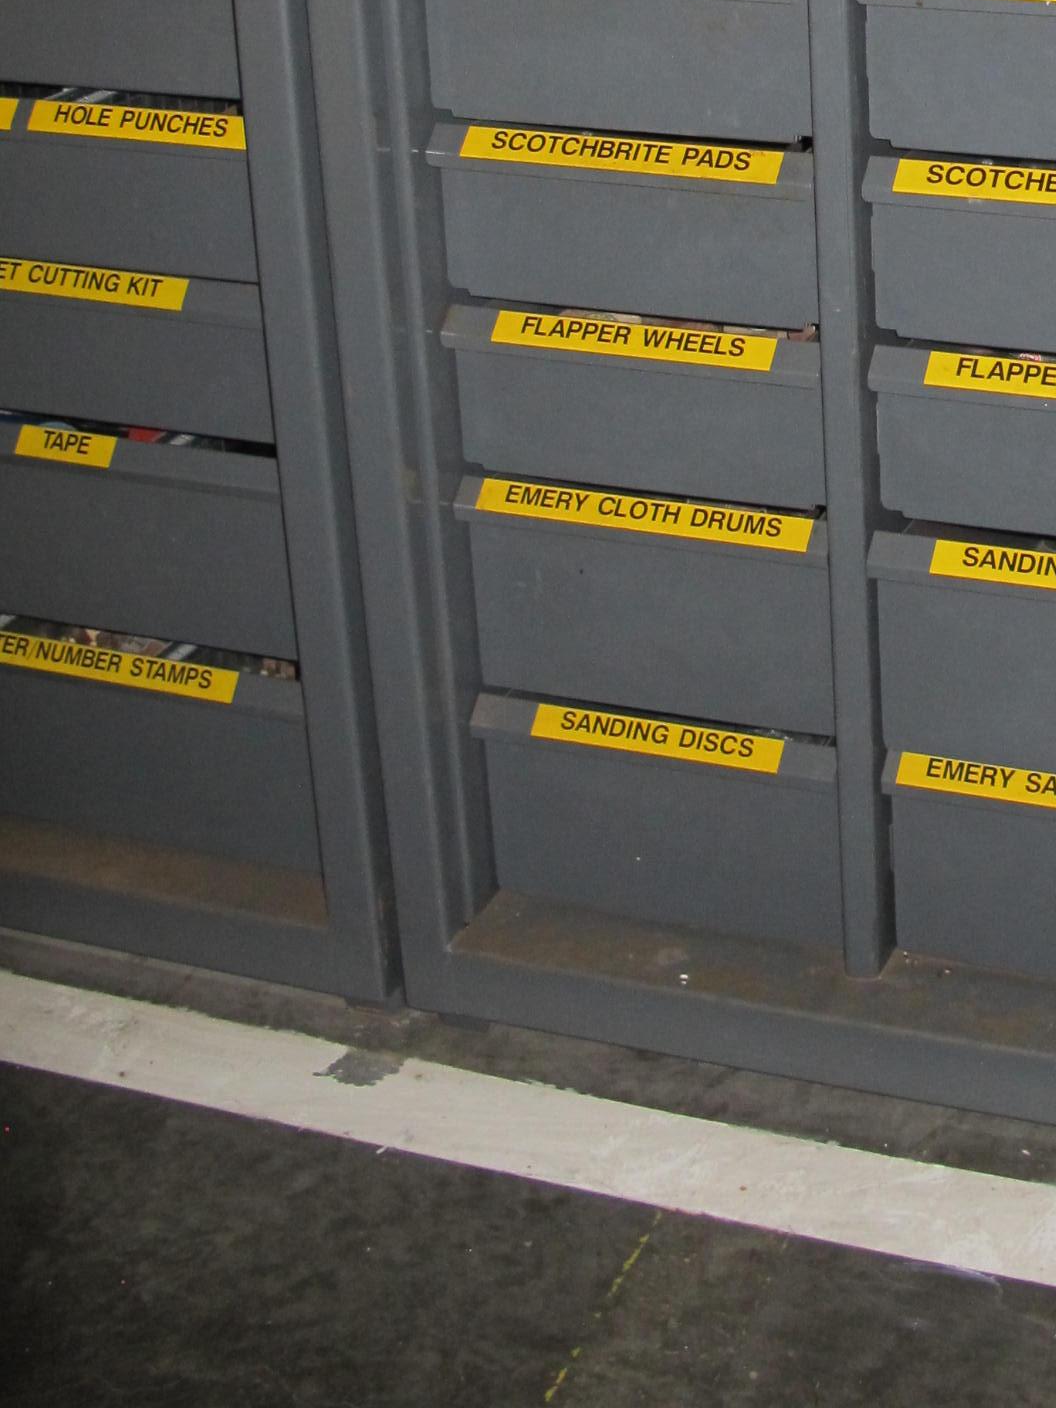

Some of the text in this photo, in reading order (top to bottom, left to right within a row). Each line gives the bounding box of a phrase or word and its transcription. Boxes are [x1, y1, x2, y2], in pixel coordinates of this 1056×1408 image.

[54, 105, 229, 138] HOLE PUNCHES
[492, 131, 752, 171] SCOTCHBRITE PADS
[28, 264, 121, 294] CUTTING
[127, 276, 164, 297] KIT
[521, 316, 746, 357] FLAPPER WHEELS
[44, 430, 93, 455] TAPE
[505, 485, 783, 538] EMERY CLOTH DRUMS
[130, 658, 213, 689] STAMPS
[561, 711, 755, 758] SANDING DISCS
[927, 758, 1016, 789] EMERY
